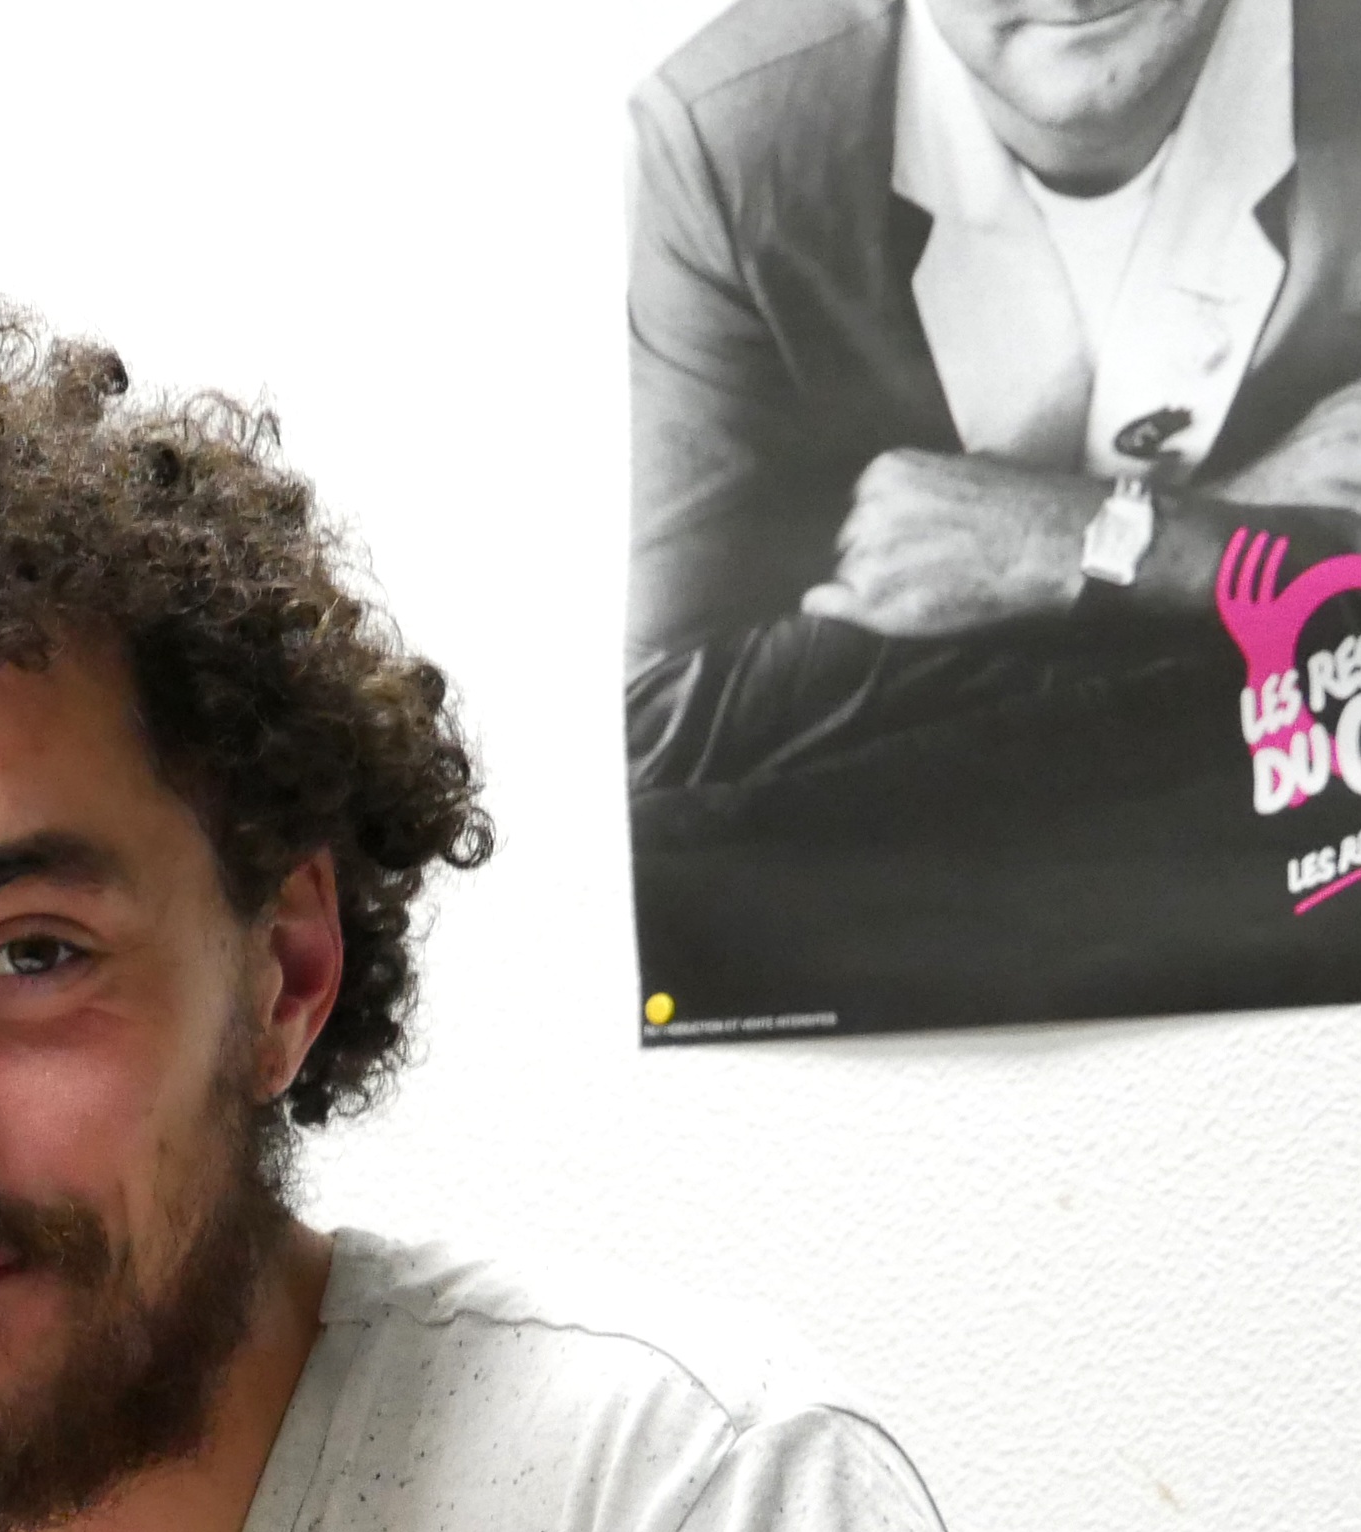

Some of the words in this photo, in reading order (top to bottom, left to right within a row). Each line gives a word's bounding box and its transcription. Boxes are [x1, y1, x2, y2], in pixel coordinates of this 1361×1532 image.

[1240, 668, 1302, 744] LES
[1253, 724, 1332, 815] DU
[1287, 846, 1337, 894] LES
